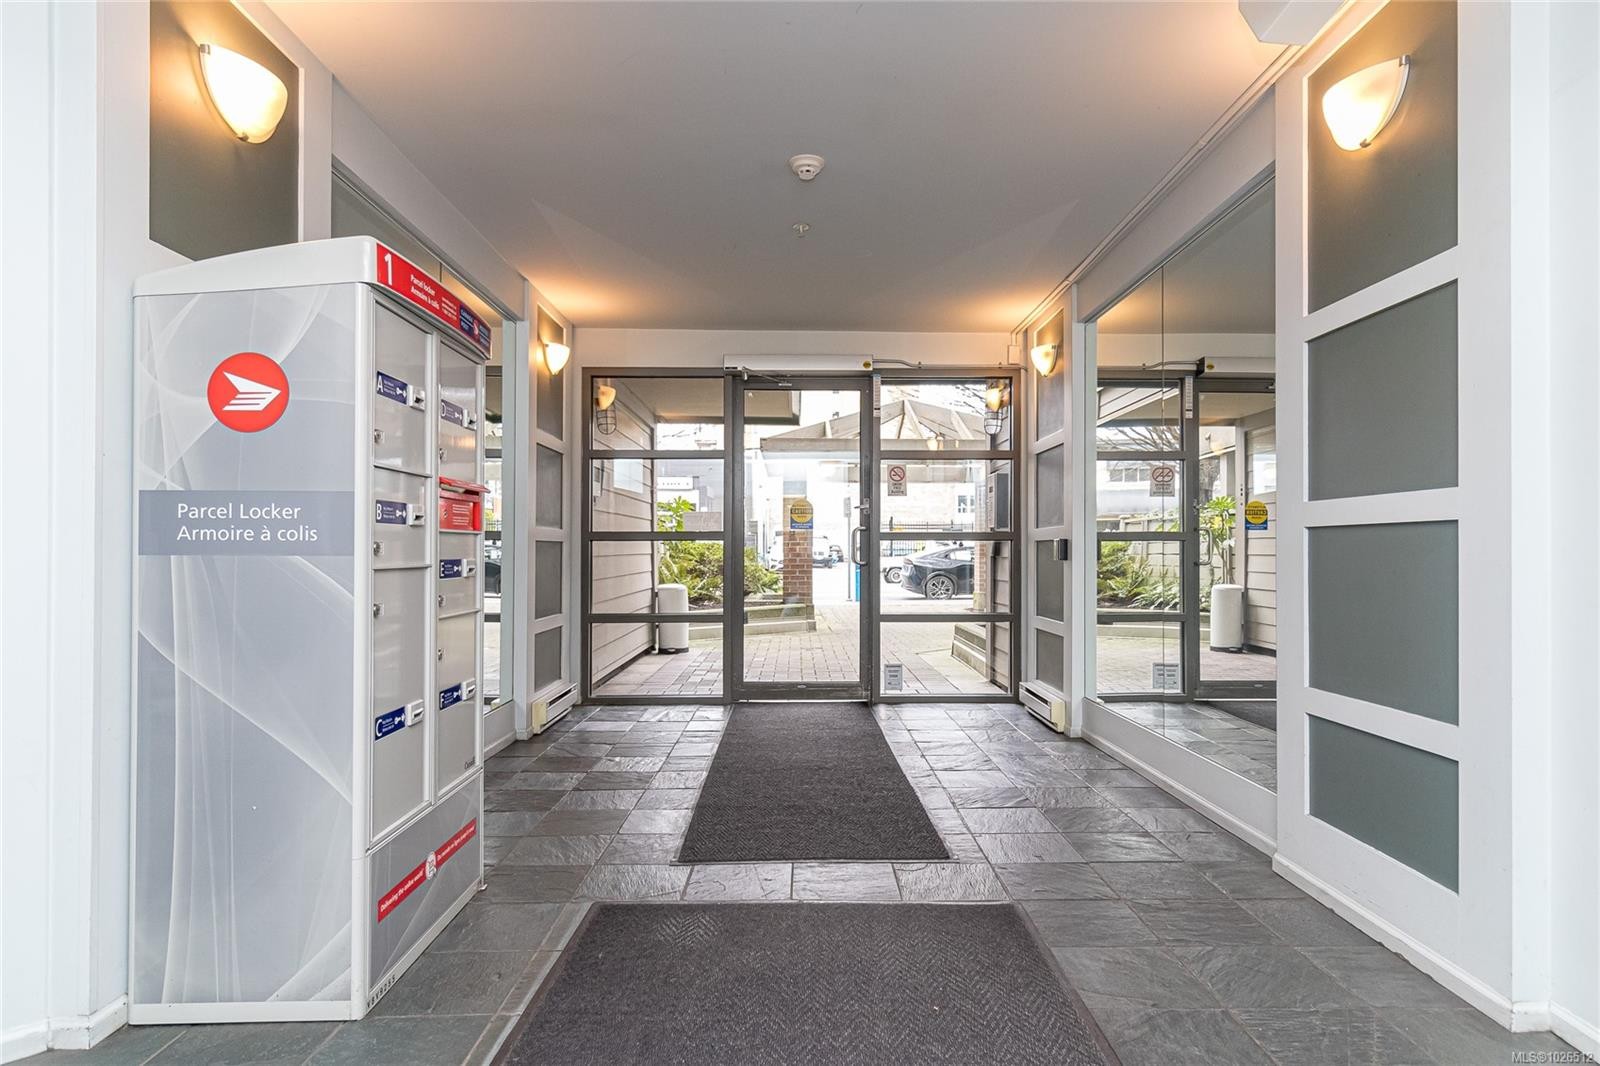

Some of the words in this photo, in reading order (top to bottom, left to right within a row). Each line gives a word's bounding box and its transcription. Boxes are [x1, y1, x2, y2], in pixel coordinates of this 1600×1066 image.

[384, 253, 393, 286] 1
[377, 375, 384, 393] A
[441, 402, 446, 417] D
[177, 503, 233, 519] Parcel
[239, 503, 301, 519] Locker
[376, 503, 382, 520] B
[176, 525, 255, 541] Armoire
[260, 525, 271, 541] à
[277, 525, 319, 541] colis
[440, 562, 445, 577] E
[440, 692, 445, 709] F
[375, 719, 383, 737] C
